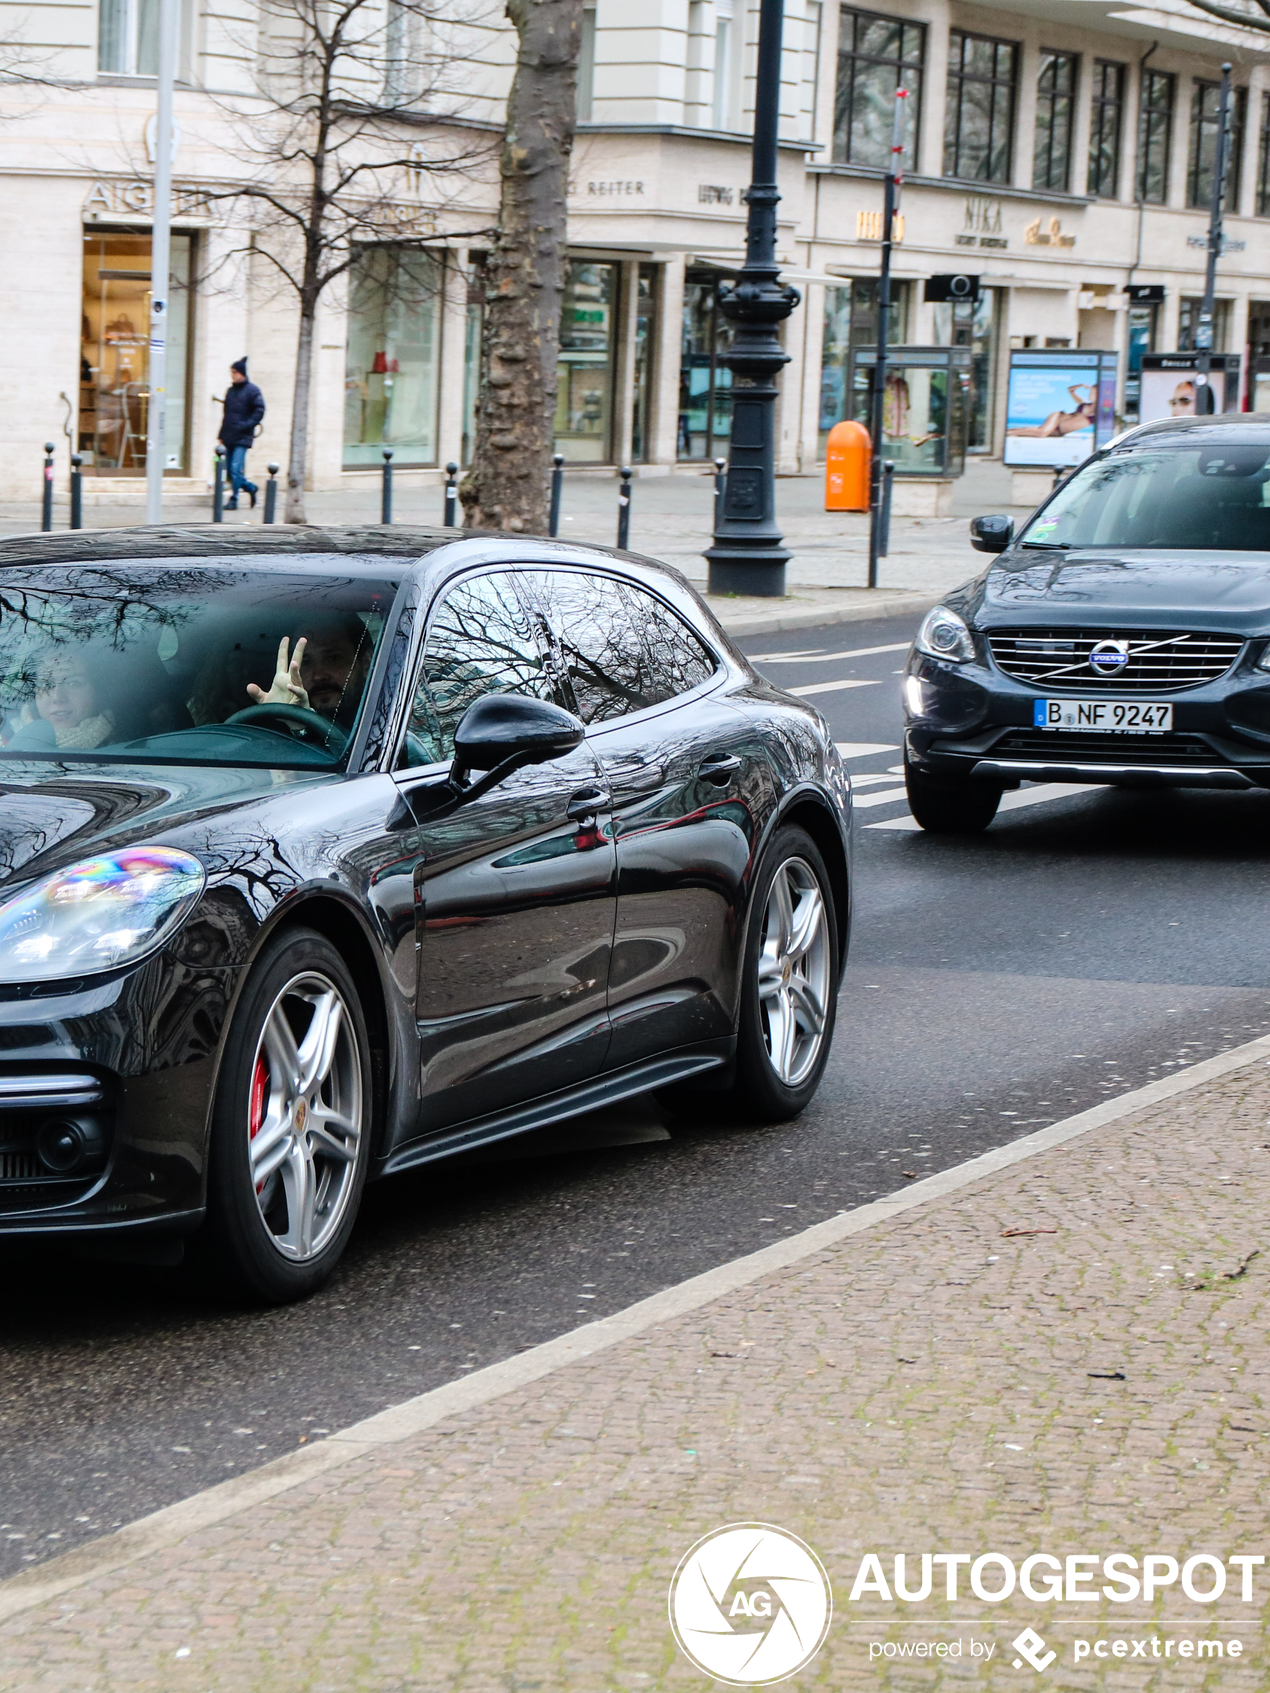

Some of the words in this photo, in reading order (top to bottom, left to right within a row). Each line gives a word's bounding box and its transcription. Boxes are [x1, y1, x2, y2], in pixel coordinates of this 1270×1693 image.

[82, 181, 214, 214] AIGER
[587, 181, 644, 195] REITER
[964, 197, 1003, 234] NIKA
[1048, 702, 1062, 723] B
[1078, 704, 1107, 725] NF
[1113, 705, 1170, 727] 9247
